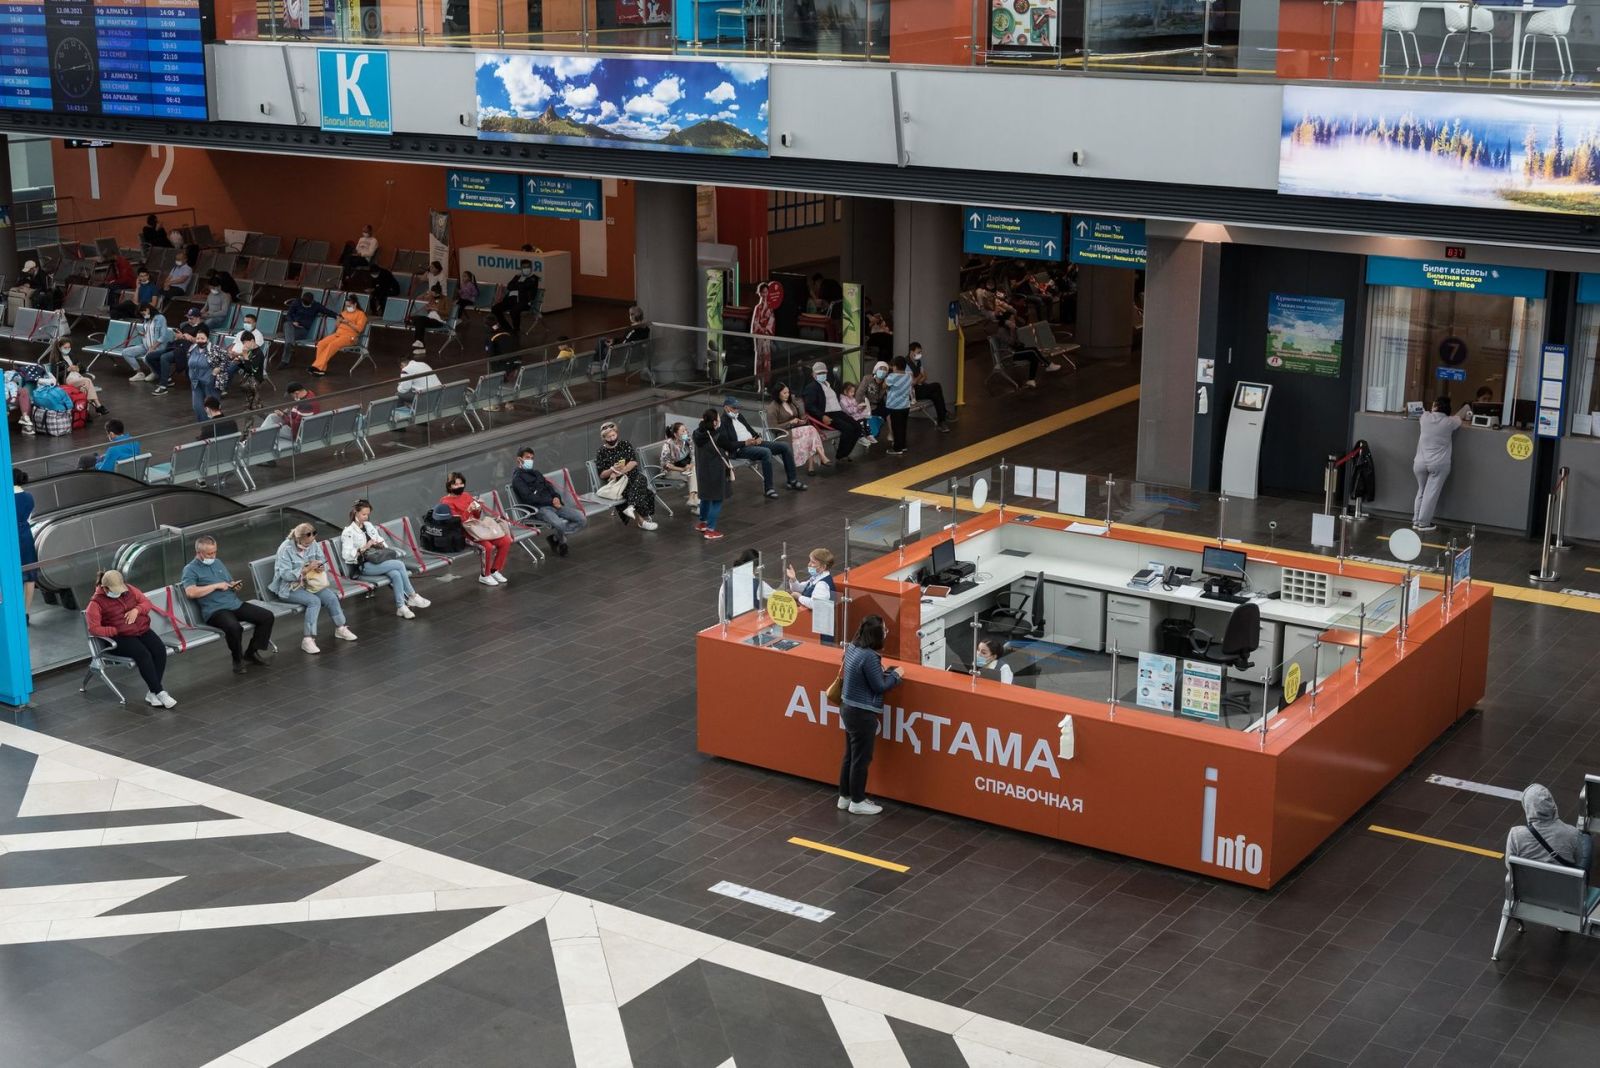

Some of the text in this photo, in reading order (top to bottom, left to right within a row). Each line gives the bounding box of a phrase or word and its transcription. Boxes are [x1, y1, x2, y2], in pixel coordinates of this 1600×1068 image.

[151, 144, 178, 206] 2
[1422, 264, 1448, 273] Билет
[1426, 272, 1459, 281] Билетная
[1433, 279, 1454, 287] Ticket
[1449, 343, 1460, 360] 7
[975, 776, 1083, 813] СПРАВОЧНАЯ
